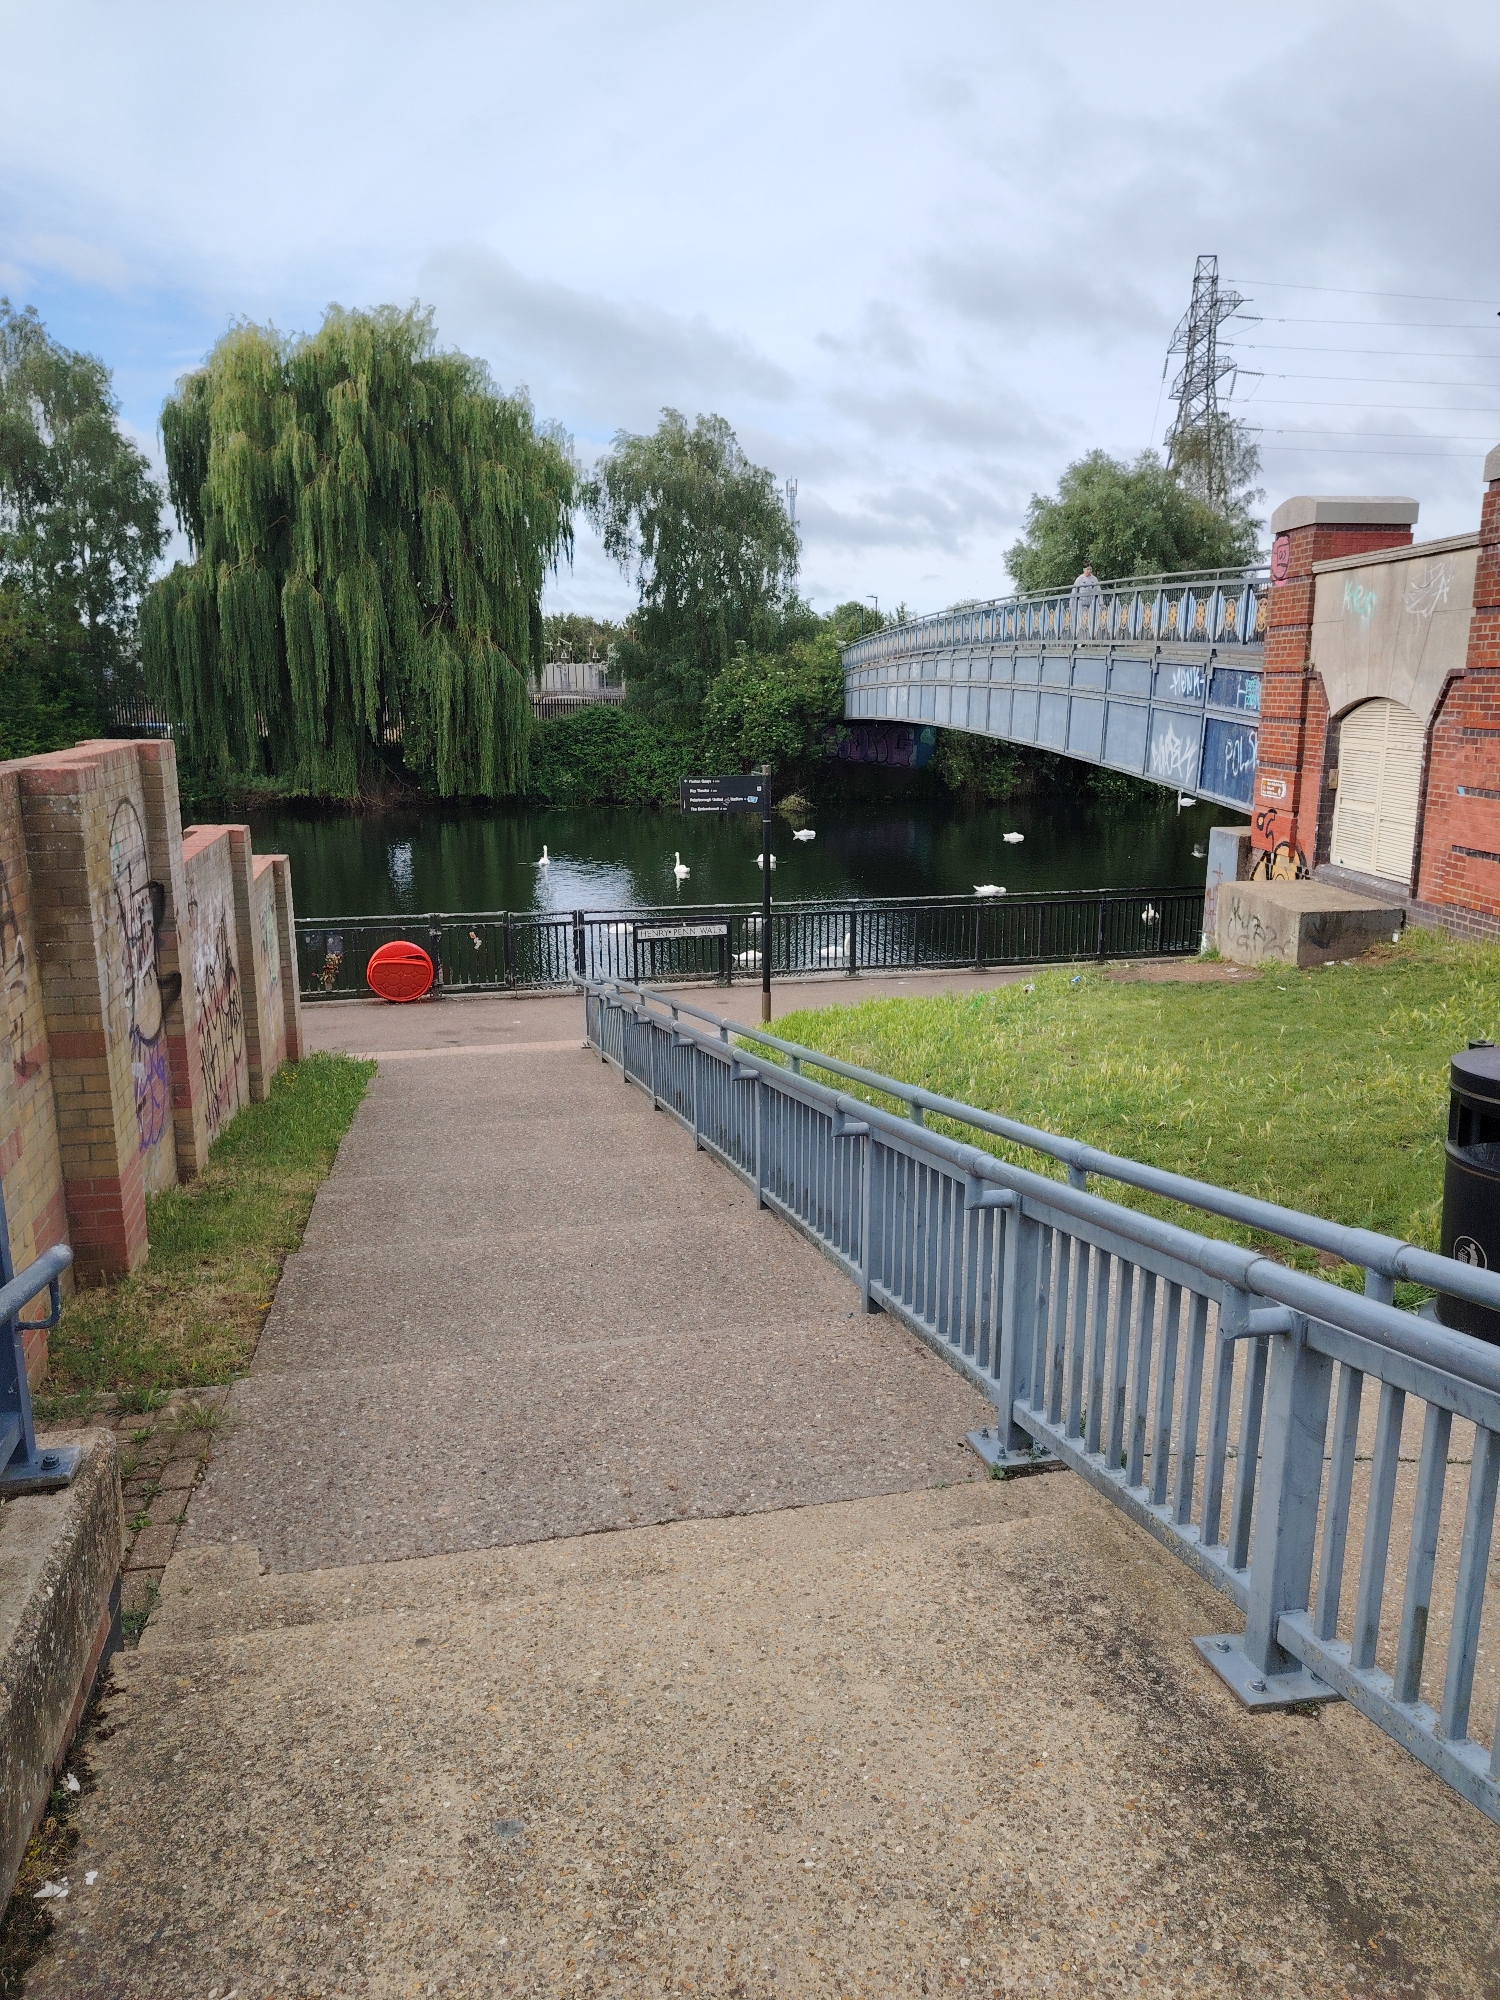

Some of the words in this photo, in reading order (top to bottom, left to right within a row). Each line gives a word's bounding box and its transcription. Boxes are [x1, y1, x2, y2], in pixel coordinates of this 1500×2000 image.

[640, 929, 669, 938] HENRY
[673, 927, 696, 936] PENN
[700, 926, 724, 935] WALK
